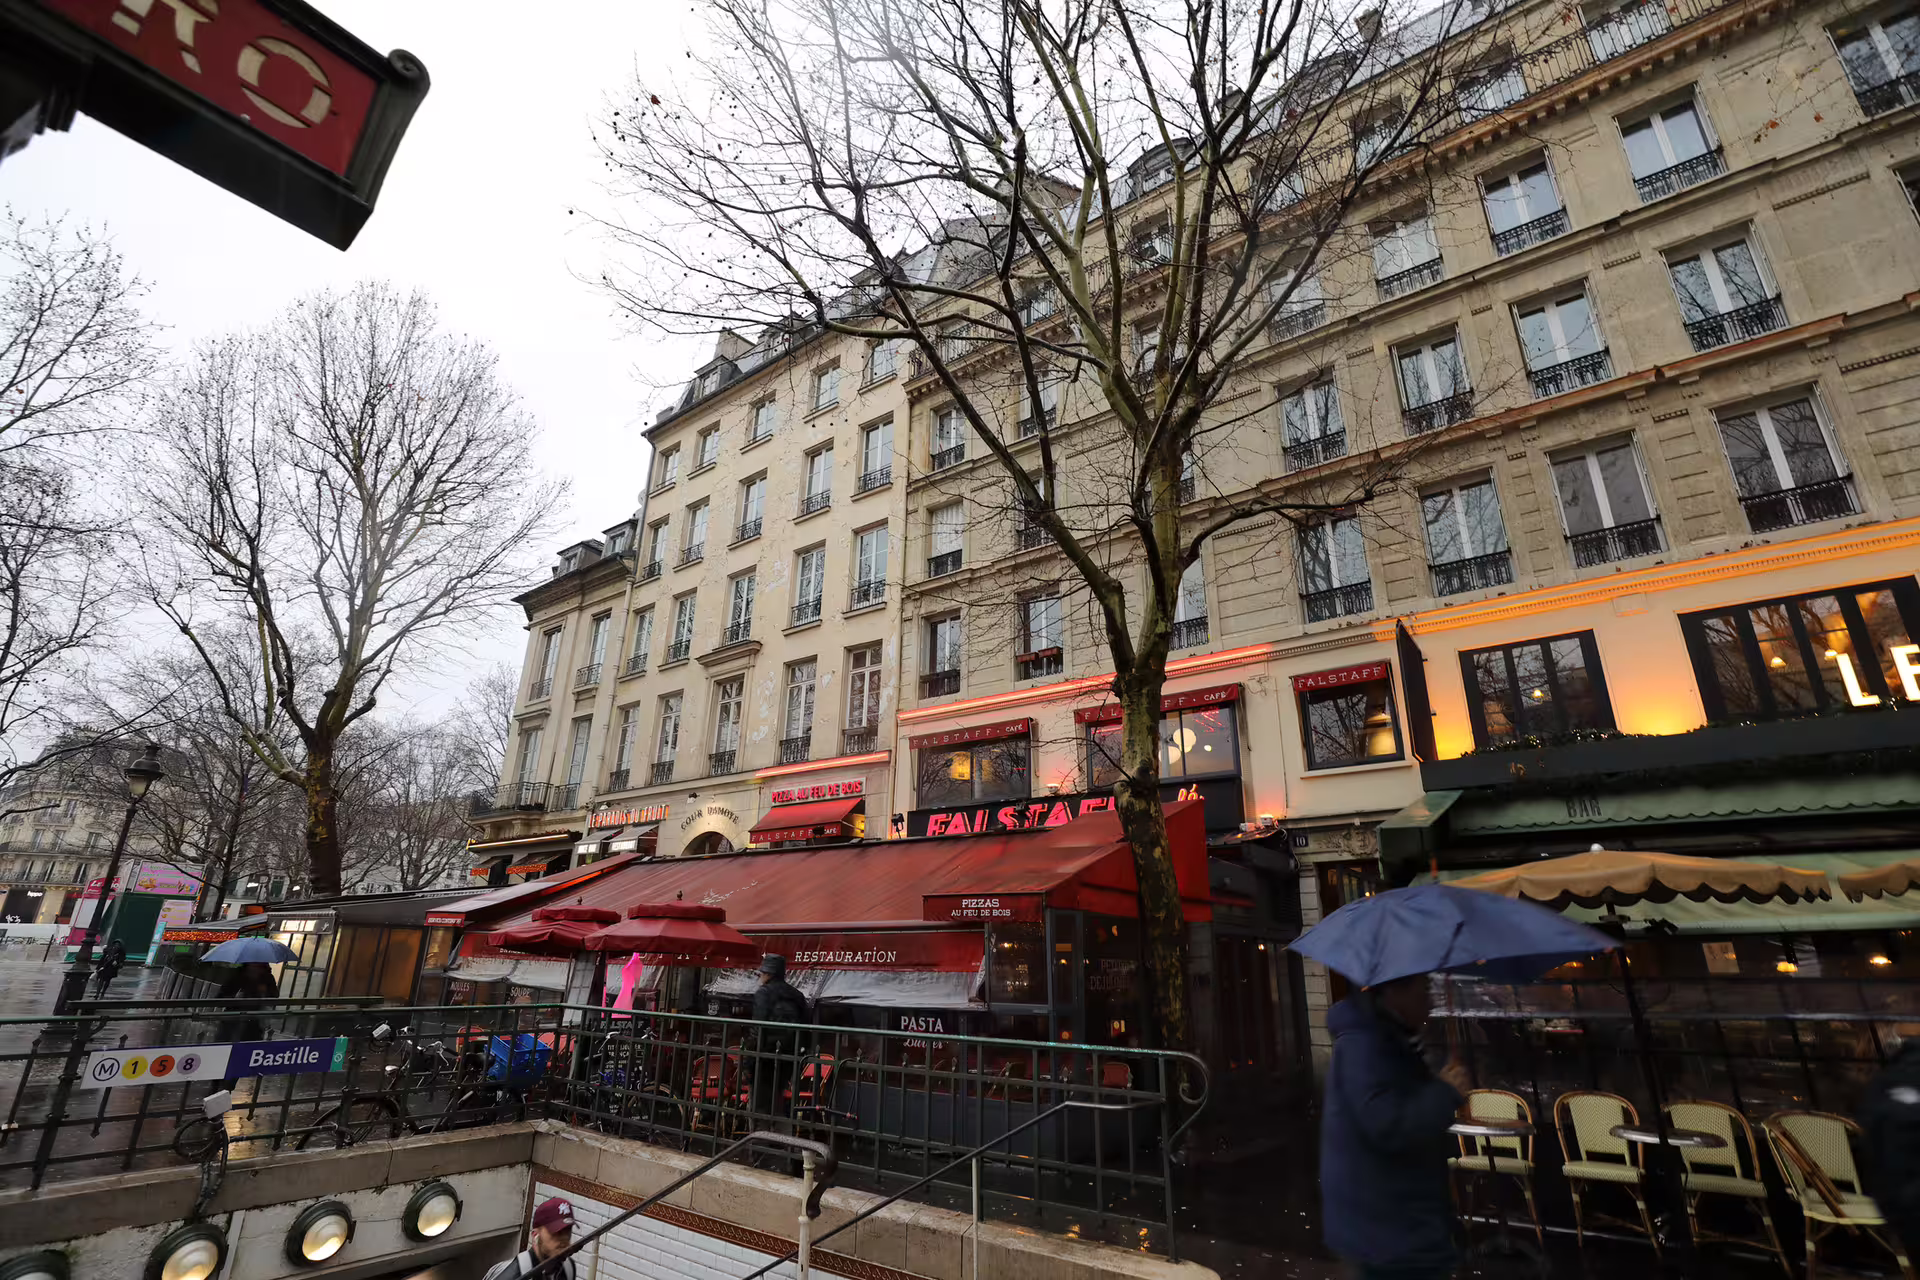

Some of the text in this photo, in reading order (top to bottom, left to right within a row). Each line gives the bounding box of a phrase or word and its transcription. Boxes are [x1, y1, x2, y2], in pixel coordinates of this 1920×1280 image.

[1298, 667, 1381, 688] FALSTAFF
[1836, 644, 1920, 707] LE
[1084, 697, 1185, 719] FALFF
[913, 728, 992, 747] FALSTAFF
[771, 780, 862, 803] PIZZA AU FEU DE BOIS
[1565, 797, 1602, 818] BAR
[680, 809, 703, 830] COUR
[751, 829, 813, 842] FALSTAFF
[1296, 836, 1306, 846] 10
[951, 909, 1011, 917] AU FEU DE BOIS
[962, 898, 1000, 908] PIZZAS
[795, 951, 897, 962] RESTAURATION
[900, 1015, 944, 1033] PASTA
[131, 1060, 139, 1074] 1
[157, 1058, 168, 1073] 5
[183, 1057, 195, 1071] 8
[249, 1046, 319, 1067] Bastille
